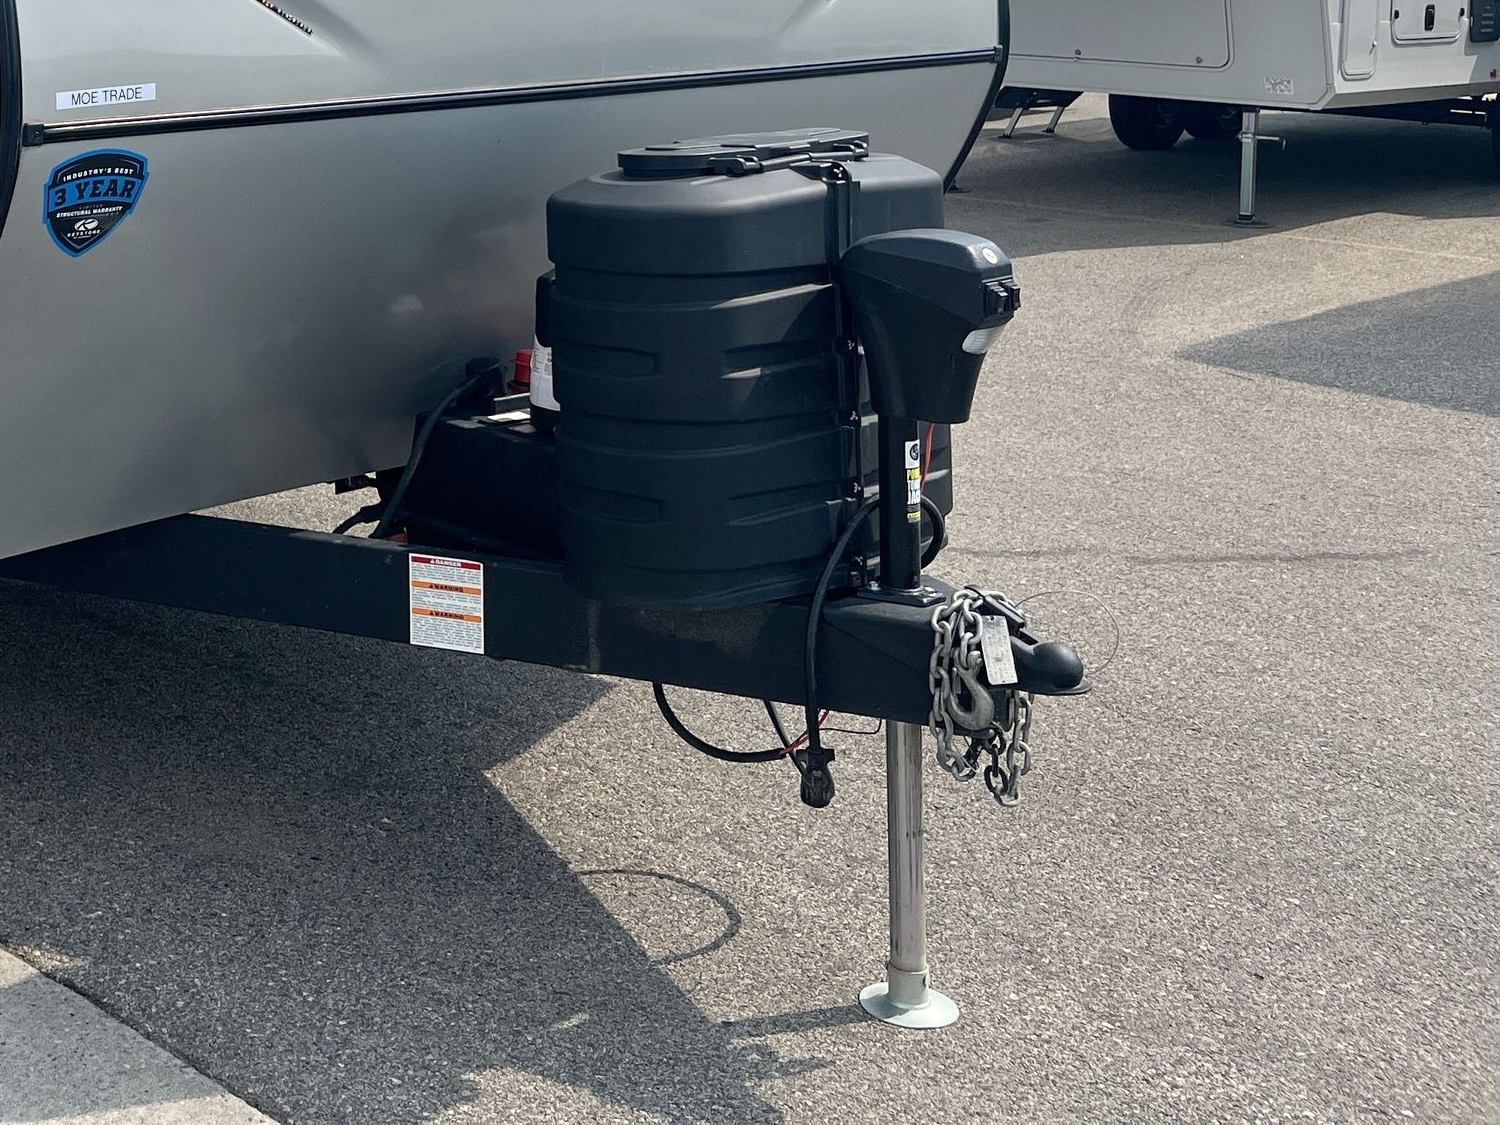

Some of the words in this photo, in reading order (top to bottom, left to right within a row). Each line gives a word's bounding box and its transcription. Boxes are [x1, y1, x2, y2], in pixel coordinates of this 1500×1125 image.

[71, 91, 99, 106] MOE
[102, 86, 143, 103] TRADE
[63, 167, 112, 182] INDUSTRY'S
[114, 167, 134, 175] BEST
[54, 187, 67, 207] 3
[75, 178, 137, 201] YEAR
[56, 209, 92, 219] STRUCTURAL
[92, 206, 123, 215] WARRANTY
[67, 229, 101, 238] KEYSTONE
[435, 559, 462, 568] DANGER
[433, 584, 464, 593] WARNING
[434, 611, 465, 620] WARNING
